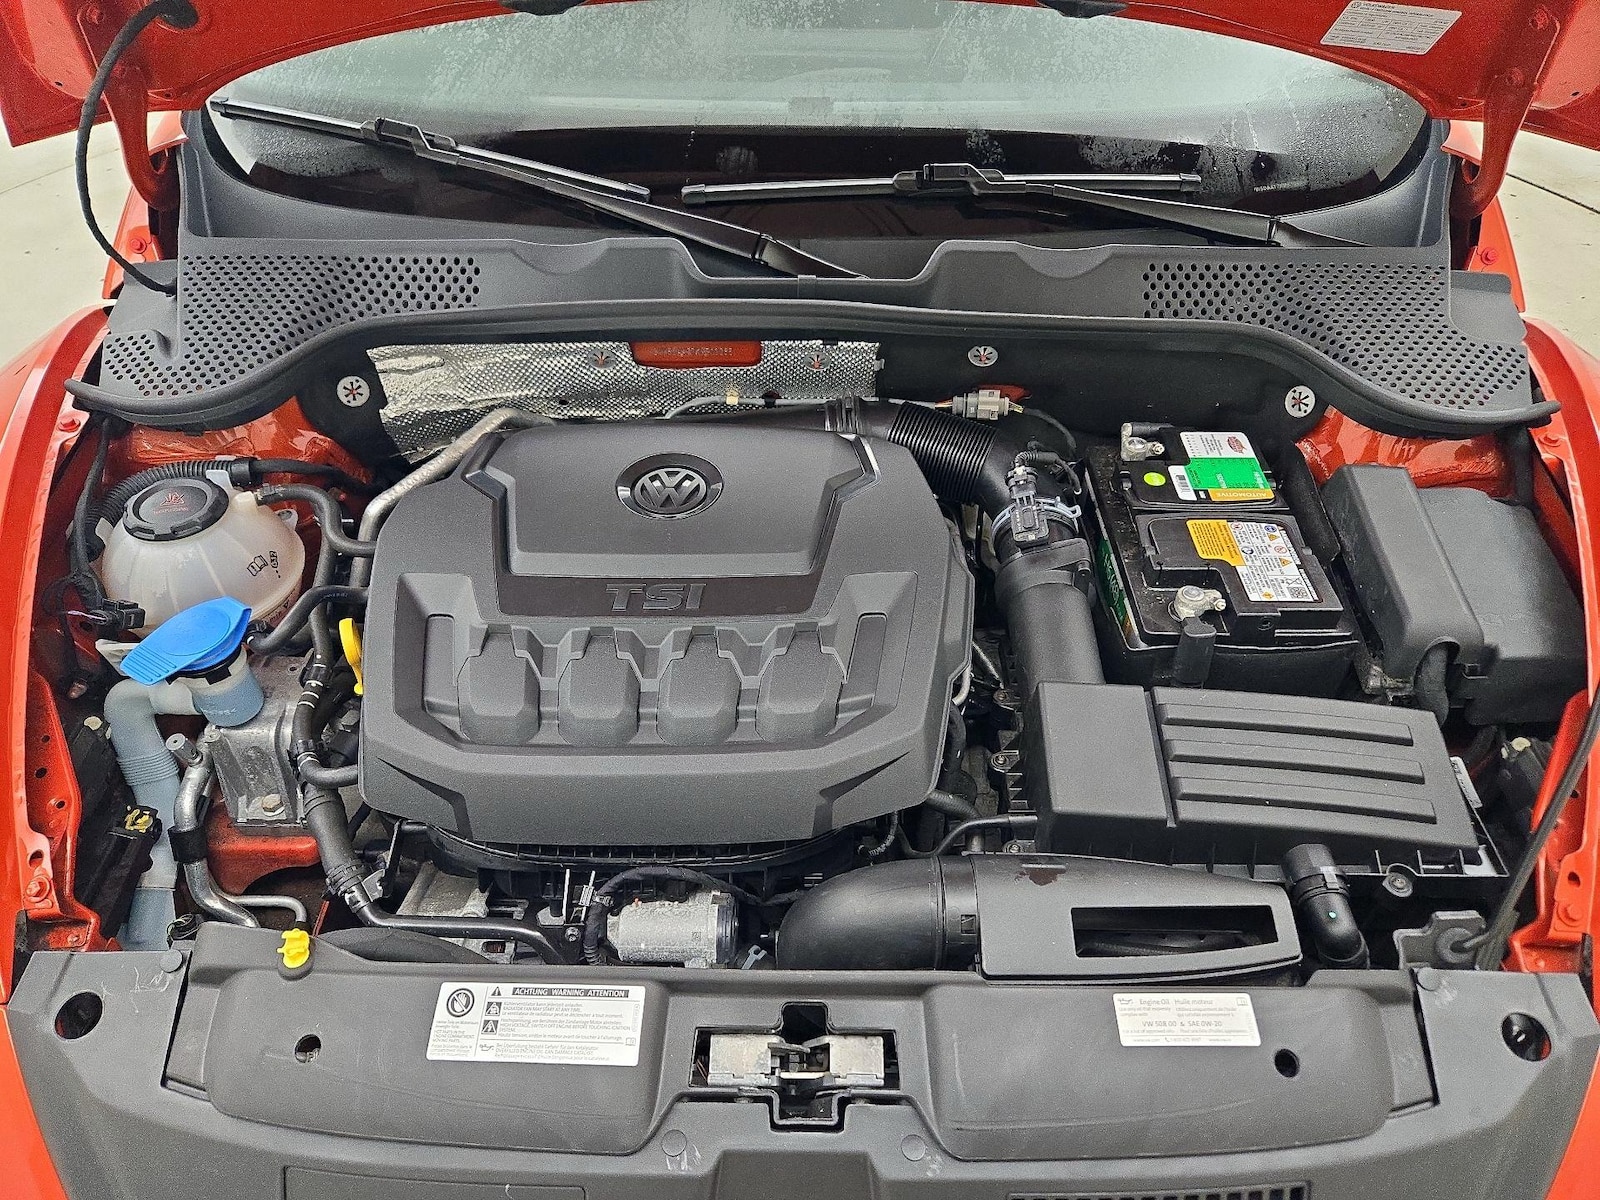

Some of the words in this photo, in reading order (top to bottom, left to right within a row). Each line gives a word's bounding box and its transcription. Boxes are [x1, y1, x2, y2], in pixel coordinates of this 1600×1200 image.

[606, 584, 706, 611] TSI
[514, 987, 548, 995] ACHTUNG
[550, 988, 584, 996] WARNING
[586, 989, 624, 997] ATTENTION
